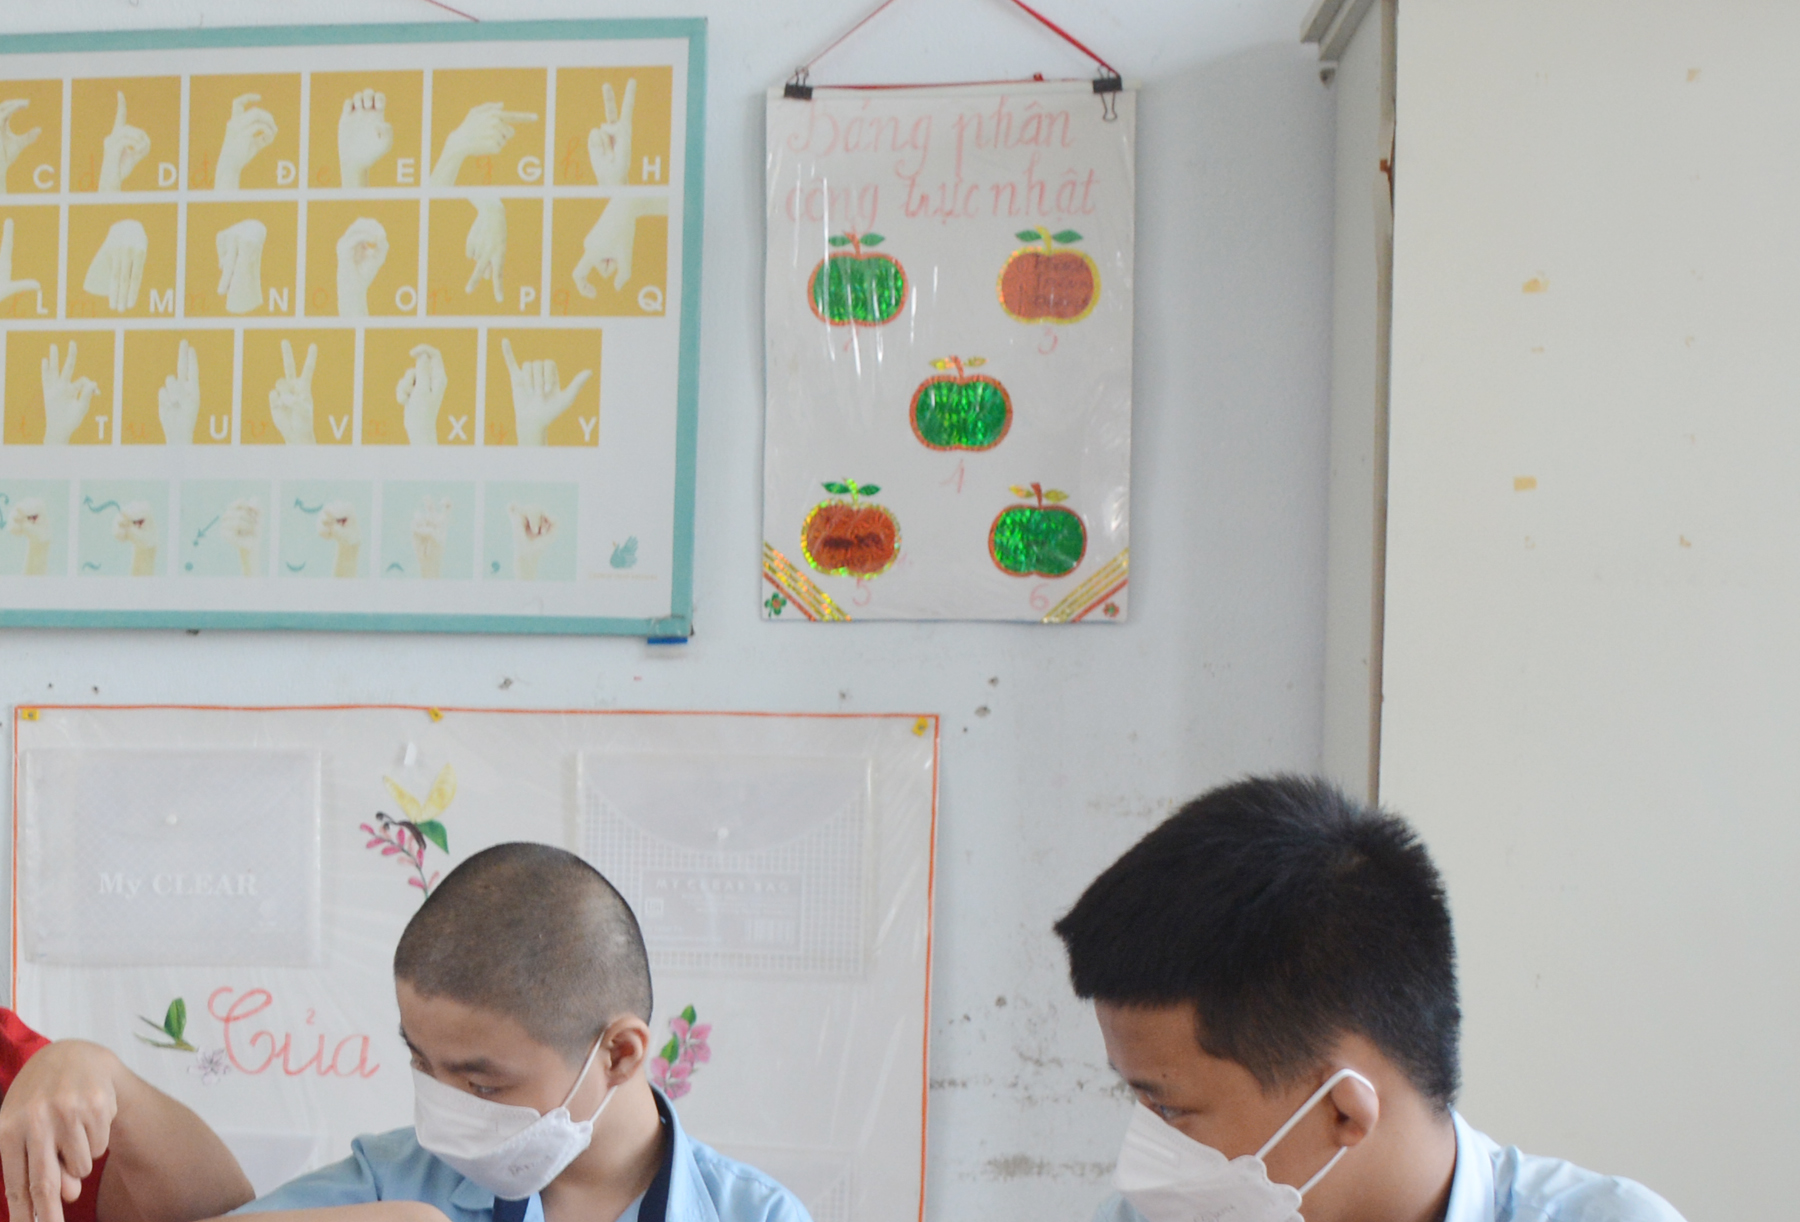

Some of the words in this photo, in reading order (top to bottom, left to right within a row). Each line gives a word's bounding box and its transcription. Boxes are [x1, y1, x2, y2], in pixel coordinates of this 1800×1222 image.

[950, 95, 1076, 184] phân
[33, 165, 54, 188] C
[158, 163, 177, 188] D
[277, 161, 296, 185] Đ
[397, 158, 414, 182] E
[518, 156, 542, 181] G
[643, 156, 660, 181] H
[990, 152, 1100, 222] nhật
[37, 290, 48, 314] L
[149, 289, 174, 313] M
[269, 288, 288, 312] N
[395, 286, 416, 311] O
[520, 287, 535, 311] P
[638, 286, 663, 311] Q
[95, 416, 108, 439] T
[210, 415, 228, 438] U
[329, 415, 348, 438] V
[448, 416, 467, 440] X
[579, 416, 597, 441] Y
[1029, 583, 1050, 611] 6
[98, 872, 142, 899] My
[152, 872, 258, 896] CLEAR
[207, 984, 381, 1079] Của
